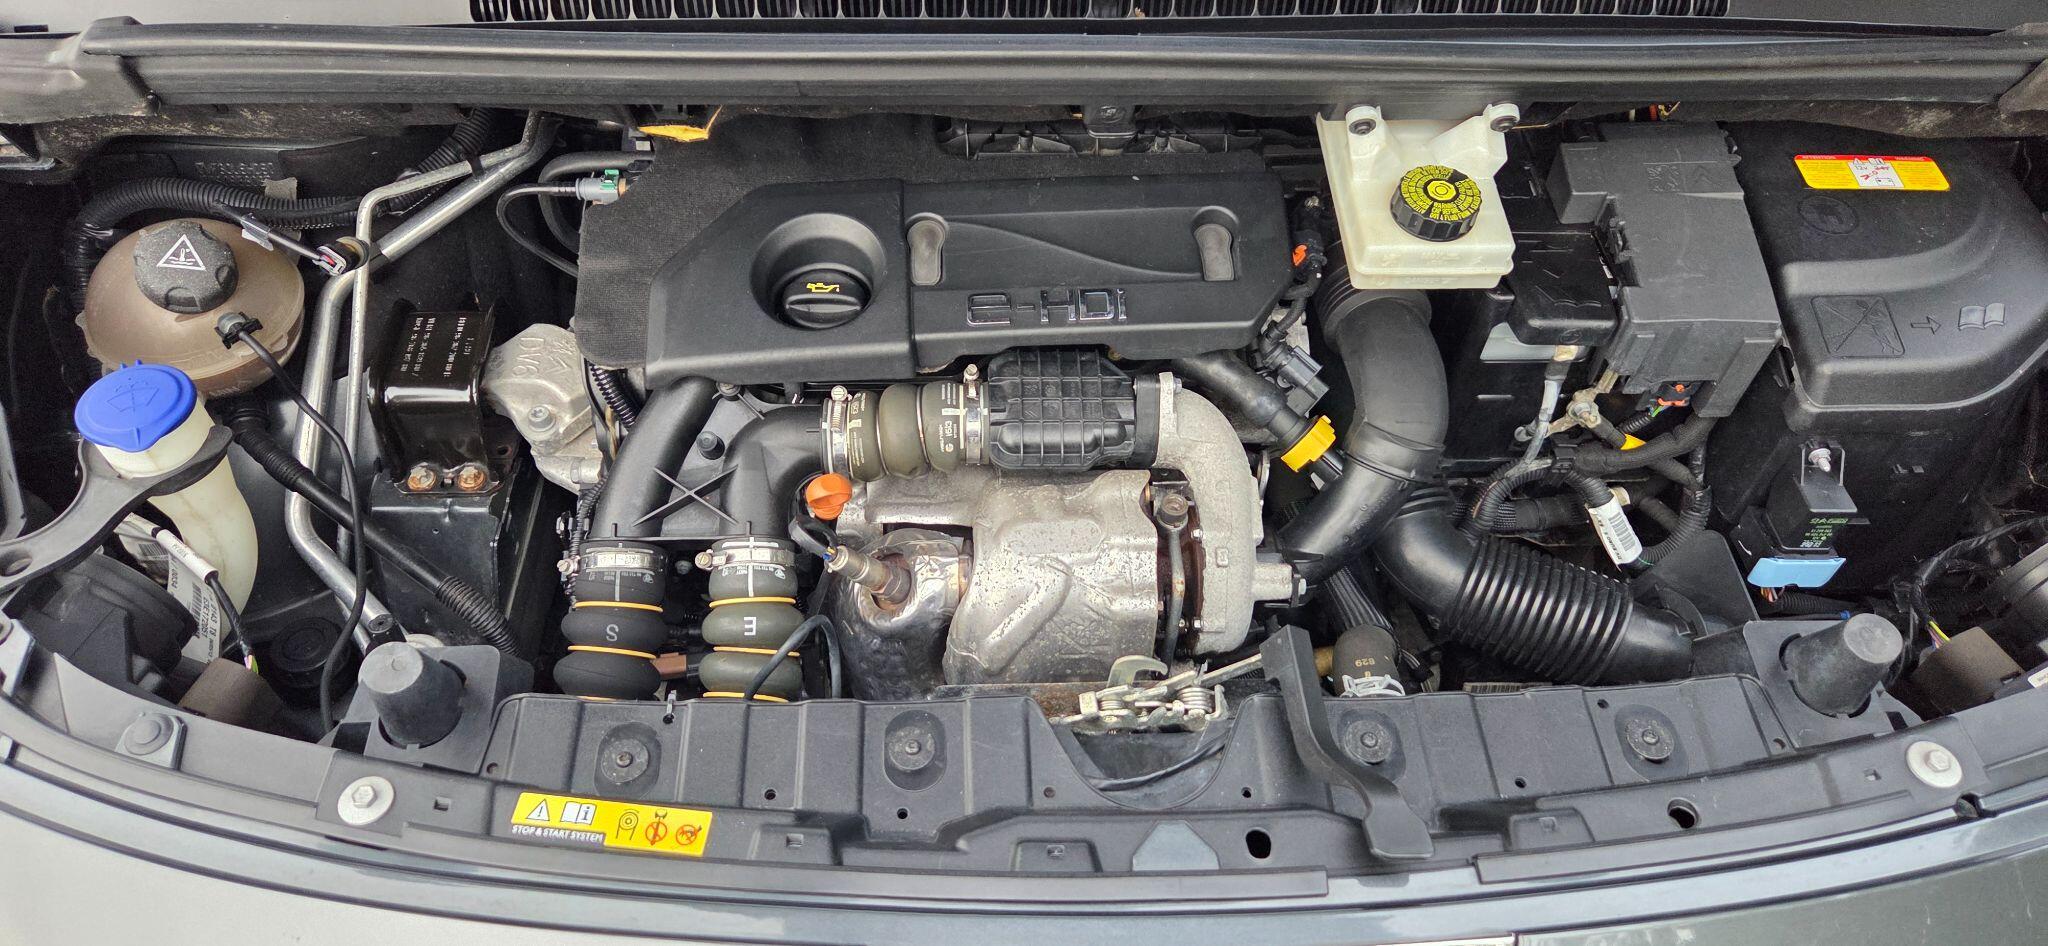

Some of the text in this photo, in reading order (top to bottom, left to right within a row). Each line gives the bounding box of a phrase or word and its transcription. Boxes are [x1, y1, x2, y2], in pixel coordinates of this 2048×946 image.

[605, 624, 619, 642] S
[743, 616, 757, 636] E
[512, 824, 603, 843] STOP & START SYSTEM
